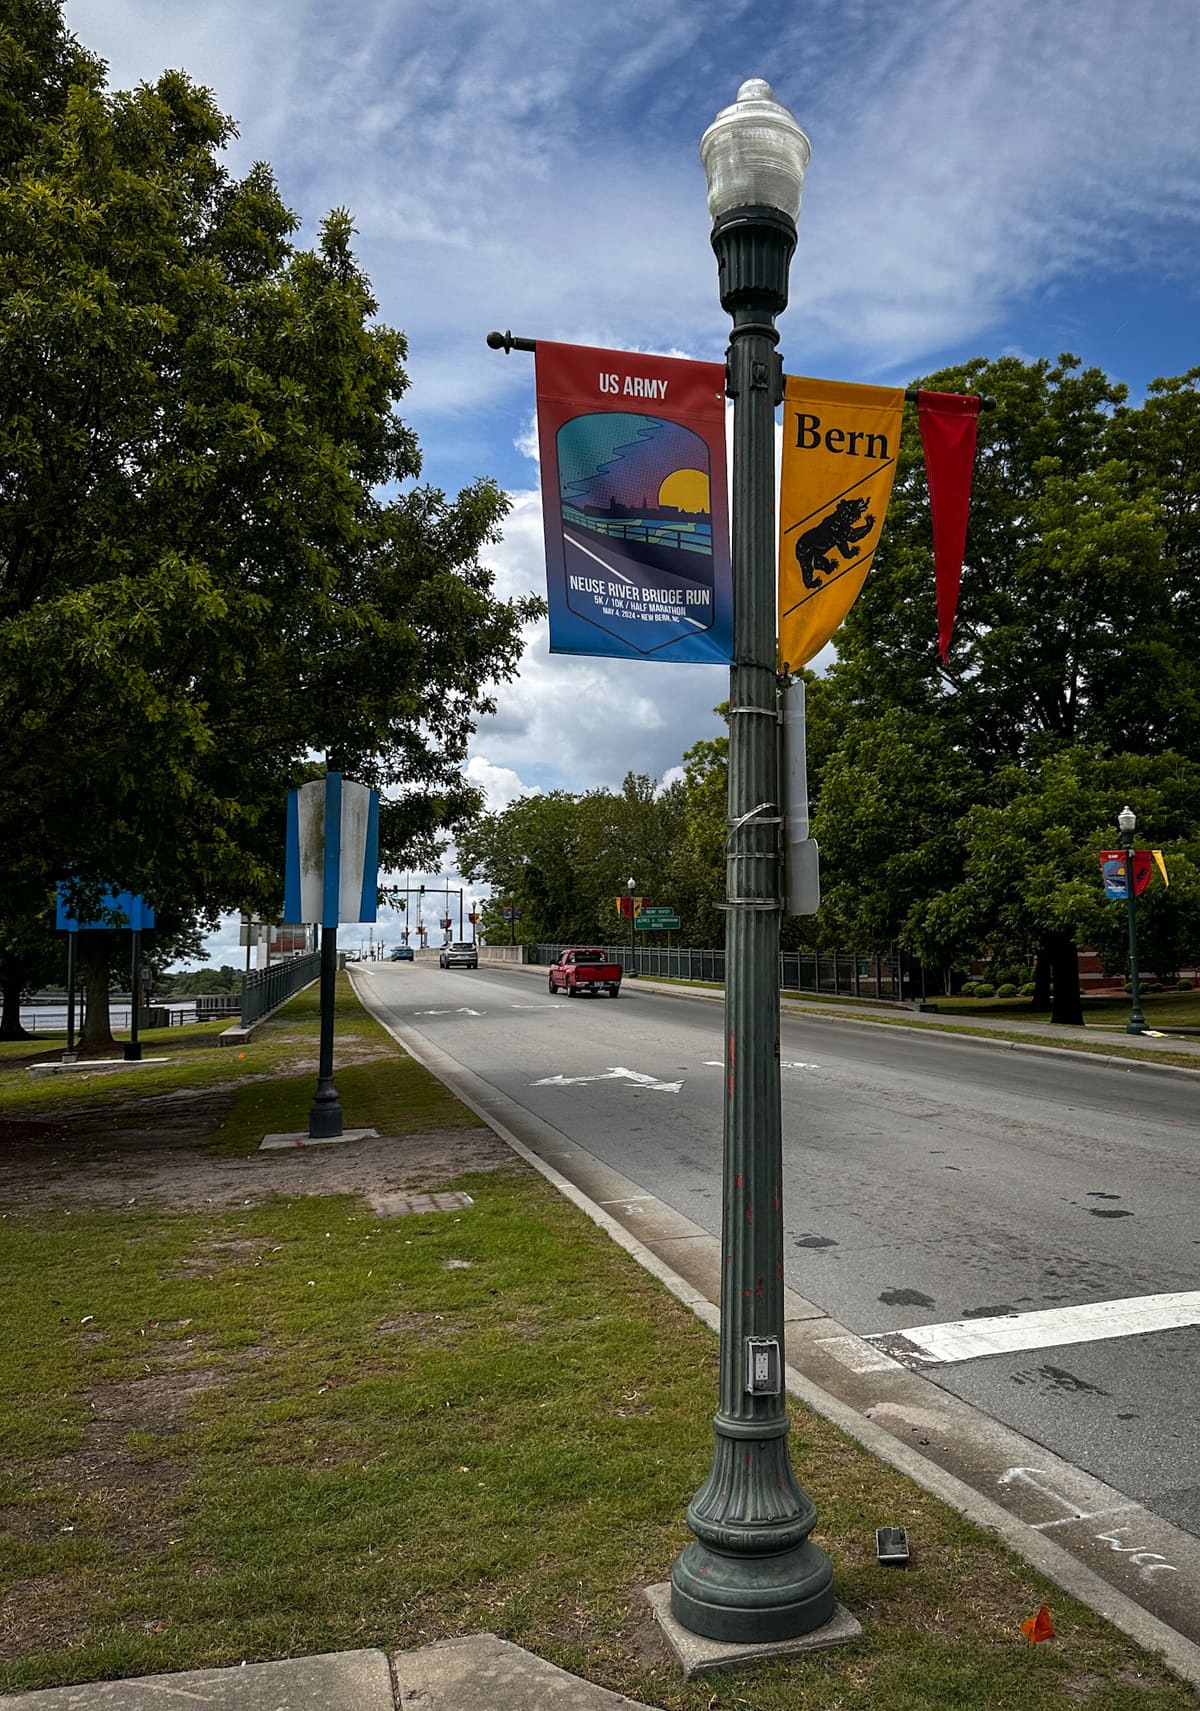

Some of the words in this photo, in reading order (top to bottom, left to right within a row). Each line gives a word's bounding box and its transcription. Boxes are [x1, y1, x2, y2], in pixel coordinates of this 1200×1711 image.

[599, 373, 619, 394] US
[623, 376, 668, 399] ARMY
[794, 412, 890, 459] Bern
[570, 576, 606, 594] NEUSE
[608, 582, 640, 601] RIVER
[642, 588, 683, 605] BRIDGE
[686, 590, 710, 605] RUN
[594, 595, 604, 605] 5K
[611, 598, 624, 609] 10K
[630, 601, 647, 611] HALF
[648, 604, 686, 616] MARATHON
[602, 607, 614, 615] MAY
